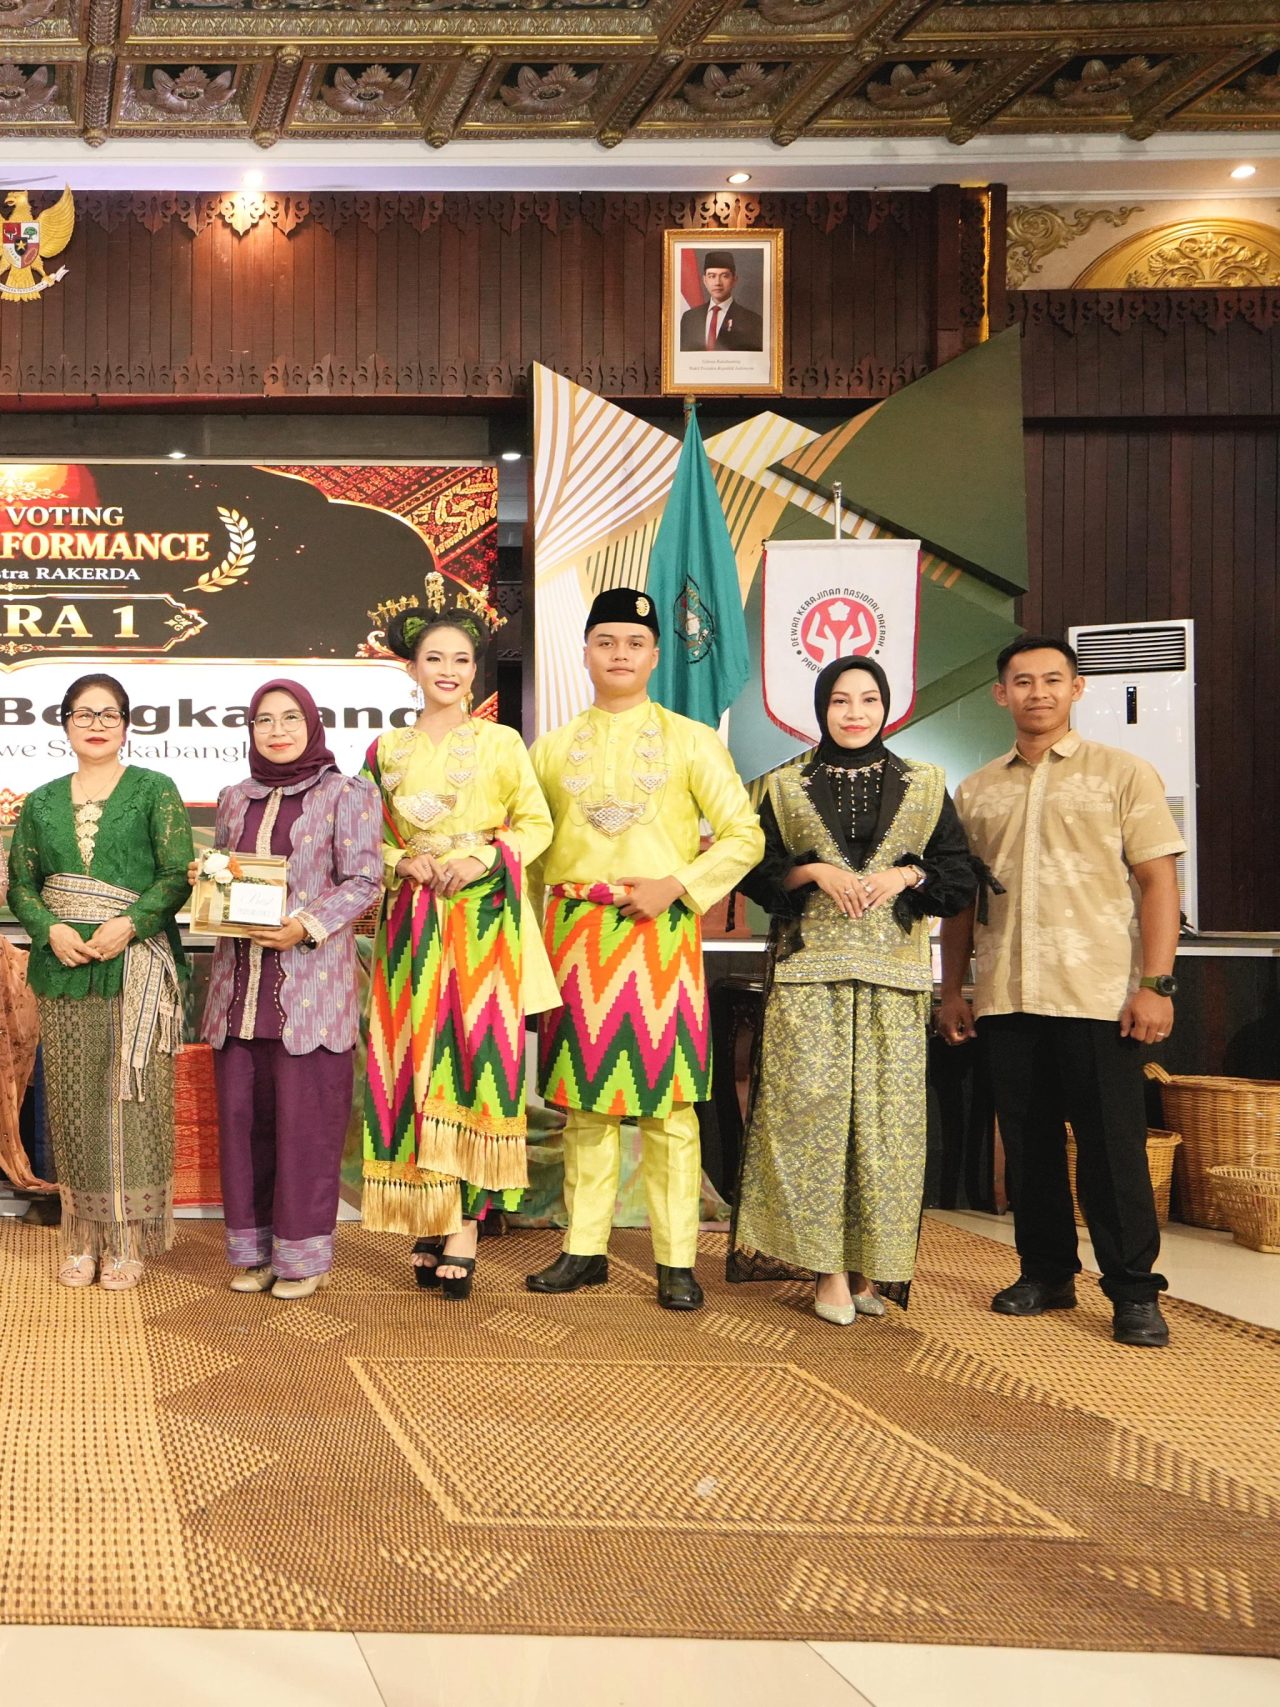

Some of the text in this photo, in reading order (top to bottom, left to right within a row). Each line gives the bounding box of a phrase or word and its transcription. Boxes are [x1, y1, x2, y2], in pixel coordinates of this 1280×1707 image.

[6, 505, 125, 527] VOTING
[36, 567, 141, 581] RAKERDA
[112, 605, 140, 638] 1
[790, 587, 886, 647] DEWAN KERAJINAN NASIONAL DAERAH
[801, 656, 824, 674] PROV
